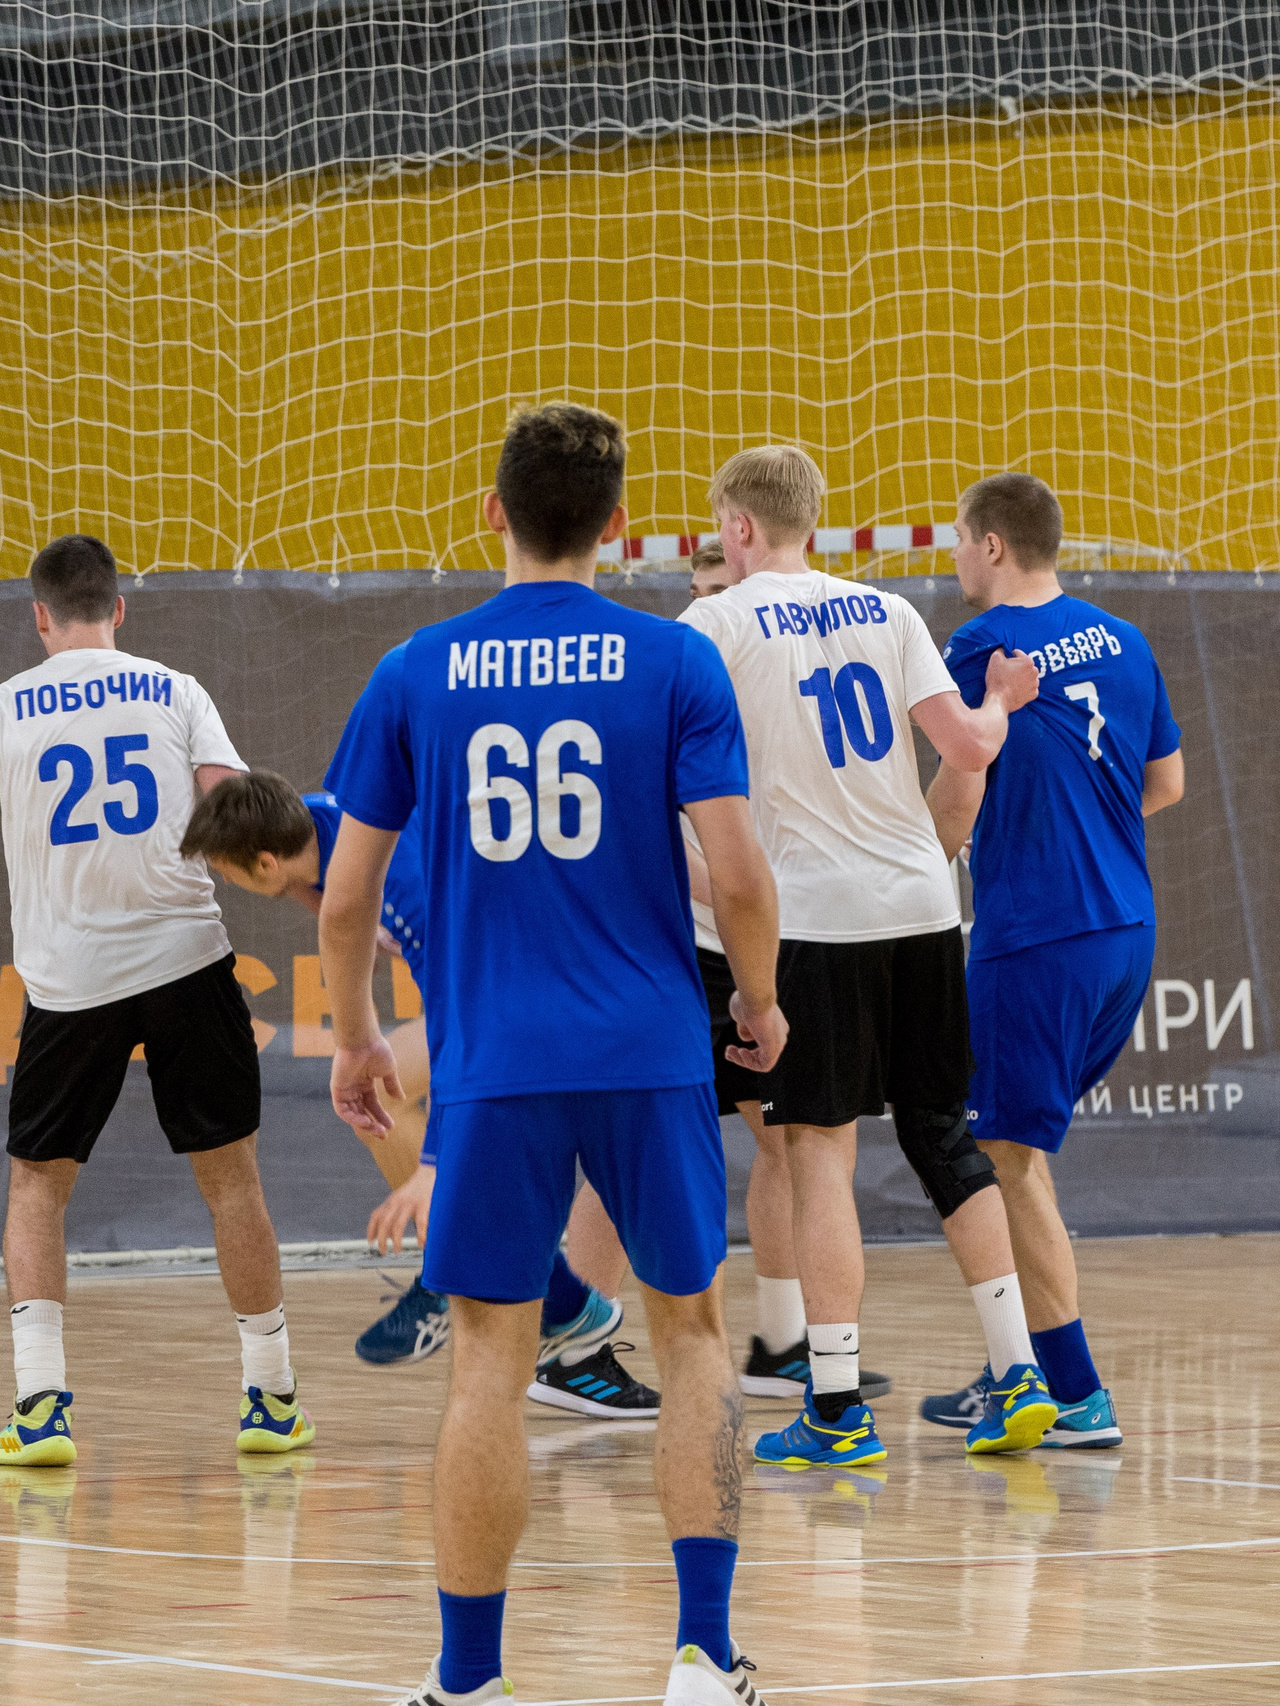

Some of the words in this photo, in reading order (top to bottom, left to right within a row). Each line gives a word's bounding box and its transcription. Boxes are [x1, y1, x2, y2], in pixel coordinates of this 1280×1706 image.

[14, 671, 173, 722] ПОБОЧИЙ
[447, 632, 626, 691] МАТВЕЕВ
[798, 661, 895, 769] 10
[1063, 680, 1107, 761] 7
[37, 733, 159, 847] 25
[466, 718, 603, 863] 66
[1128, 1083, 1244, 1119] ЦЕНТР
